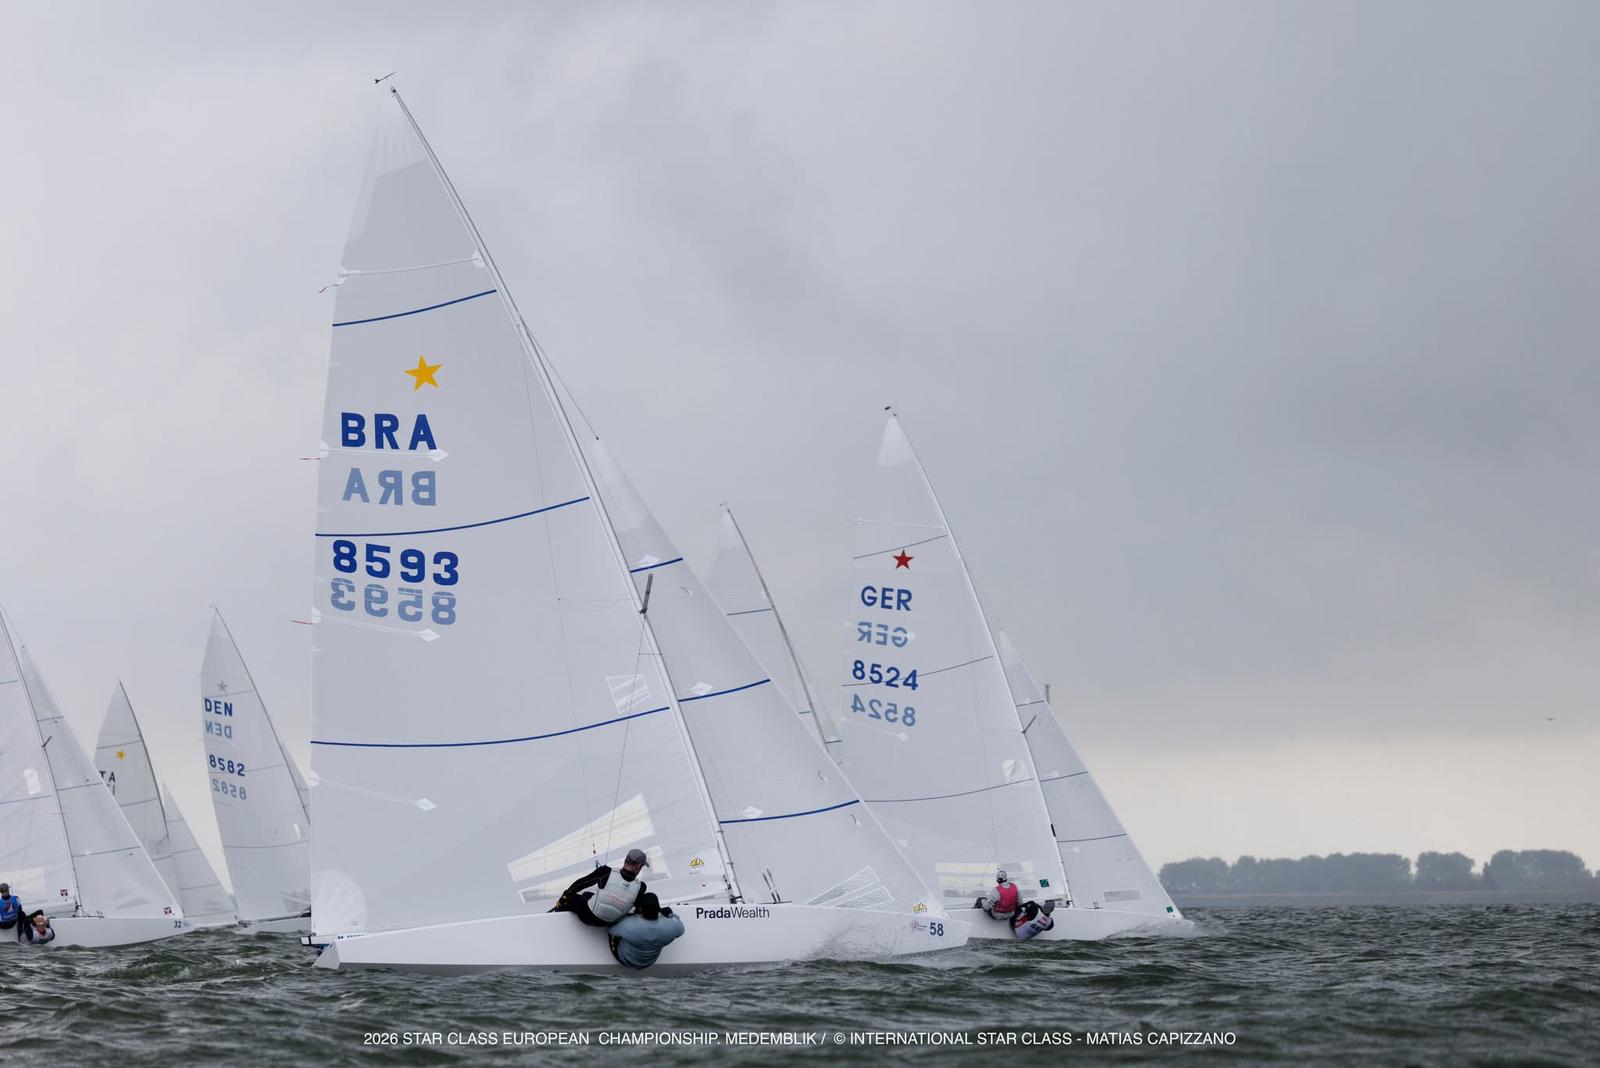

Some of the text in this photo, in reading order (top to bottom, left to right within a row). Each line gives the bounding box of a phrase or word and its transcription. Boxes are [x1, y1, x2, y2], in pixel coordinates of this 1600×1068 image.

[341, 412, 437, 451] BRA
[332, 539, 459, 586] 8593
[860, 585, 913, 612] GER
[851, 659, 918, 691] 8524
[204, 697, 234, 717] DEN
[98, 771, 116, 783] TA
[208, 754, 246, 777] 8582
[696, 906, 770, 920] PradaWealth
[929, 922, 944, 936] 58
